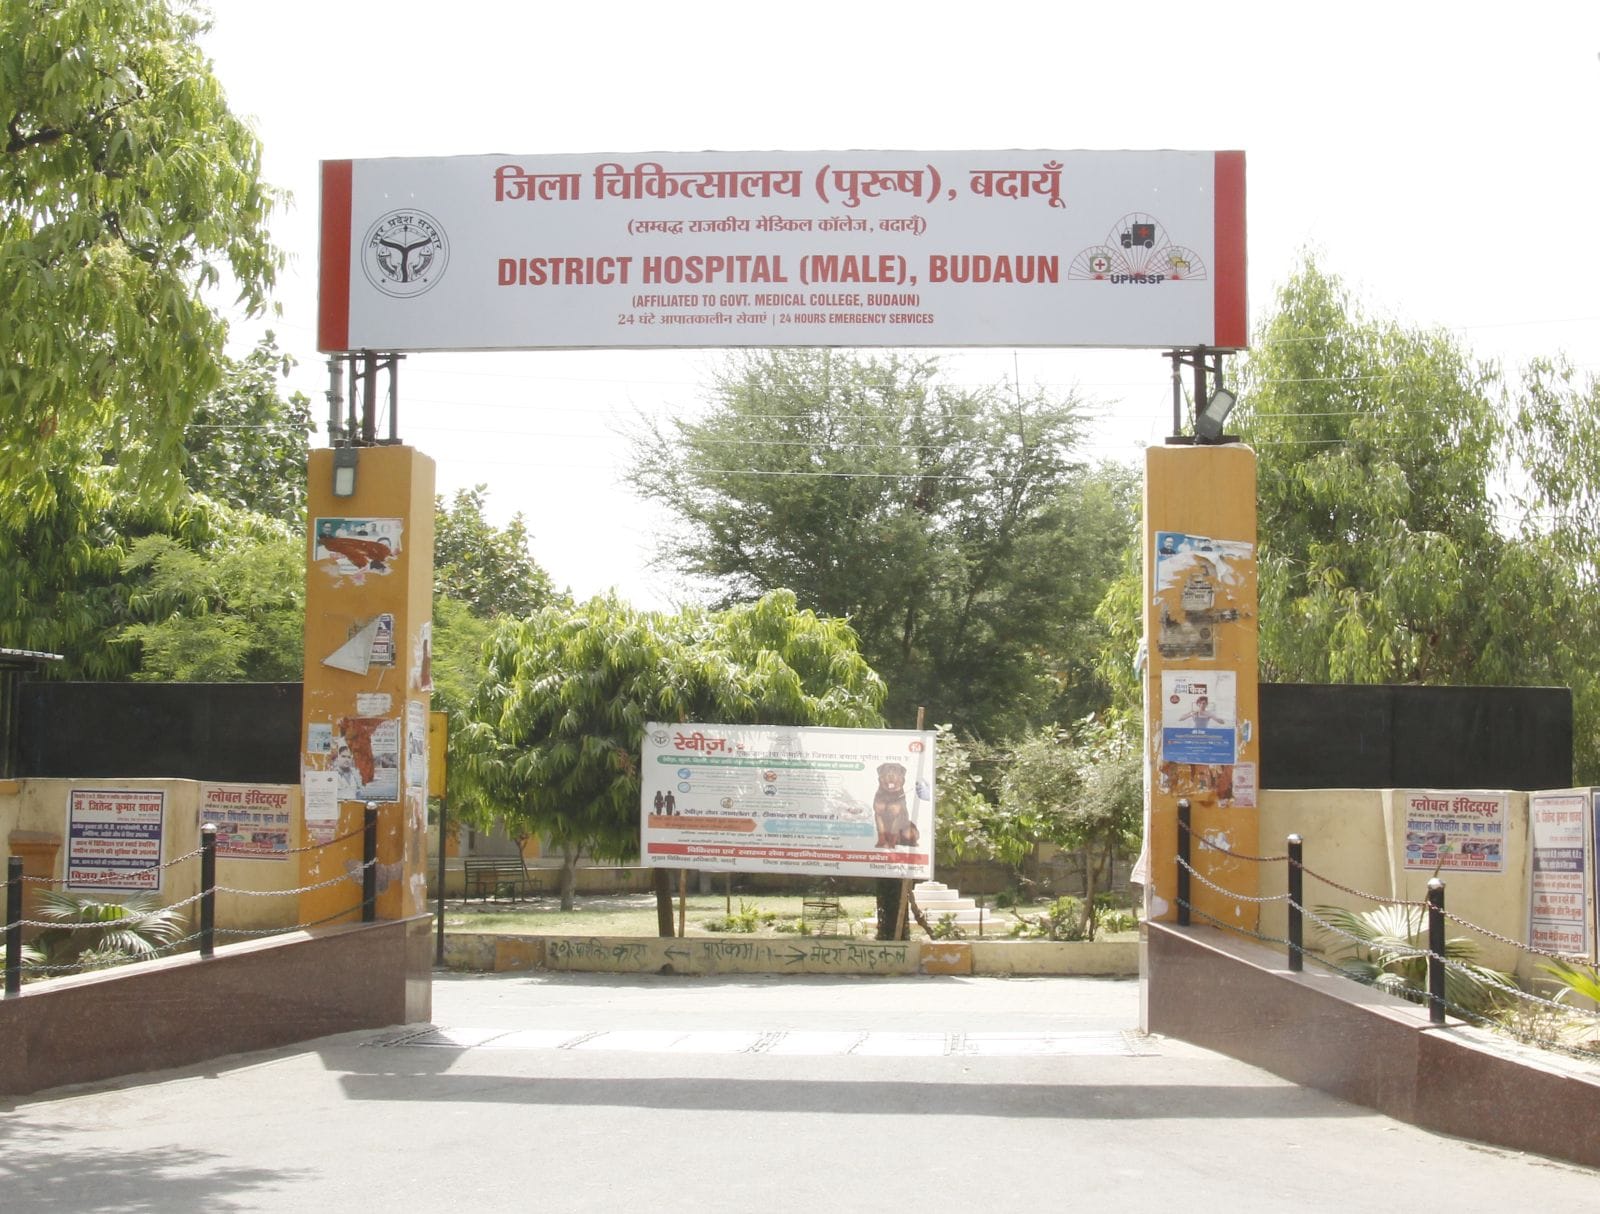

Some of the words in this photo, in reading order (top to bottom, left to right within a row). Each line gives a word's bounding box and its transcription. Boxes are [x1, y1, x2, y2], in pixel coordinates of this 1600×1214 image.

[493, 164, 582, 202] जिला
[592, 162, 803, 200] चिकित्सालय
[969, 159, 1067, 209] बदायूँ
[688, 215, 750, 233] राजकीय
[756, 215, 813, 232] मेडिकल
[498, 256, 633, 287] DISTRICT
[643, 255, 788, 285] HOSPITAL
[799, 254, 917, 287] (MALE),
[929, 254, 1059, 284] BUDAUN
[1110, 273, 1165, 285] UPHSSP
[632, 294, 699, 308] (AFFILIATED
[702, 294, 716, 307] TO
[719, 294, 751, 307] GOVT.
[754, 294, 807, 306] MEDICAL
[810, 293, 864, 307] COLLEGE,
[867, 293, 920, 307] BUDAUN)
[618, 314, 635, 325] 24
[660, 312, 732, 325] आपातकालीन
[779, 313, 792, 324] 24
[795, 313, 826, 324] HOURS
[829, 313, 887, 324] EMERGENCY
[889, 313, 934, 324] SERVICES
